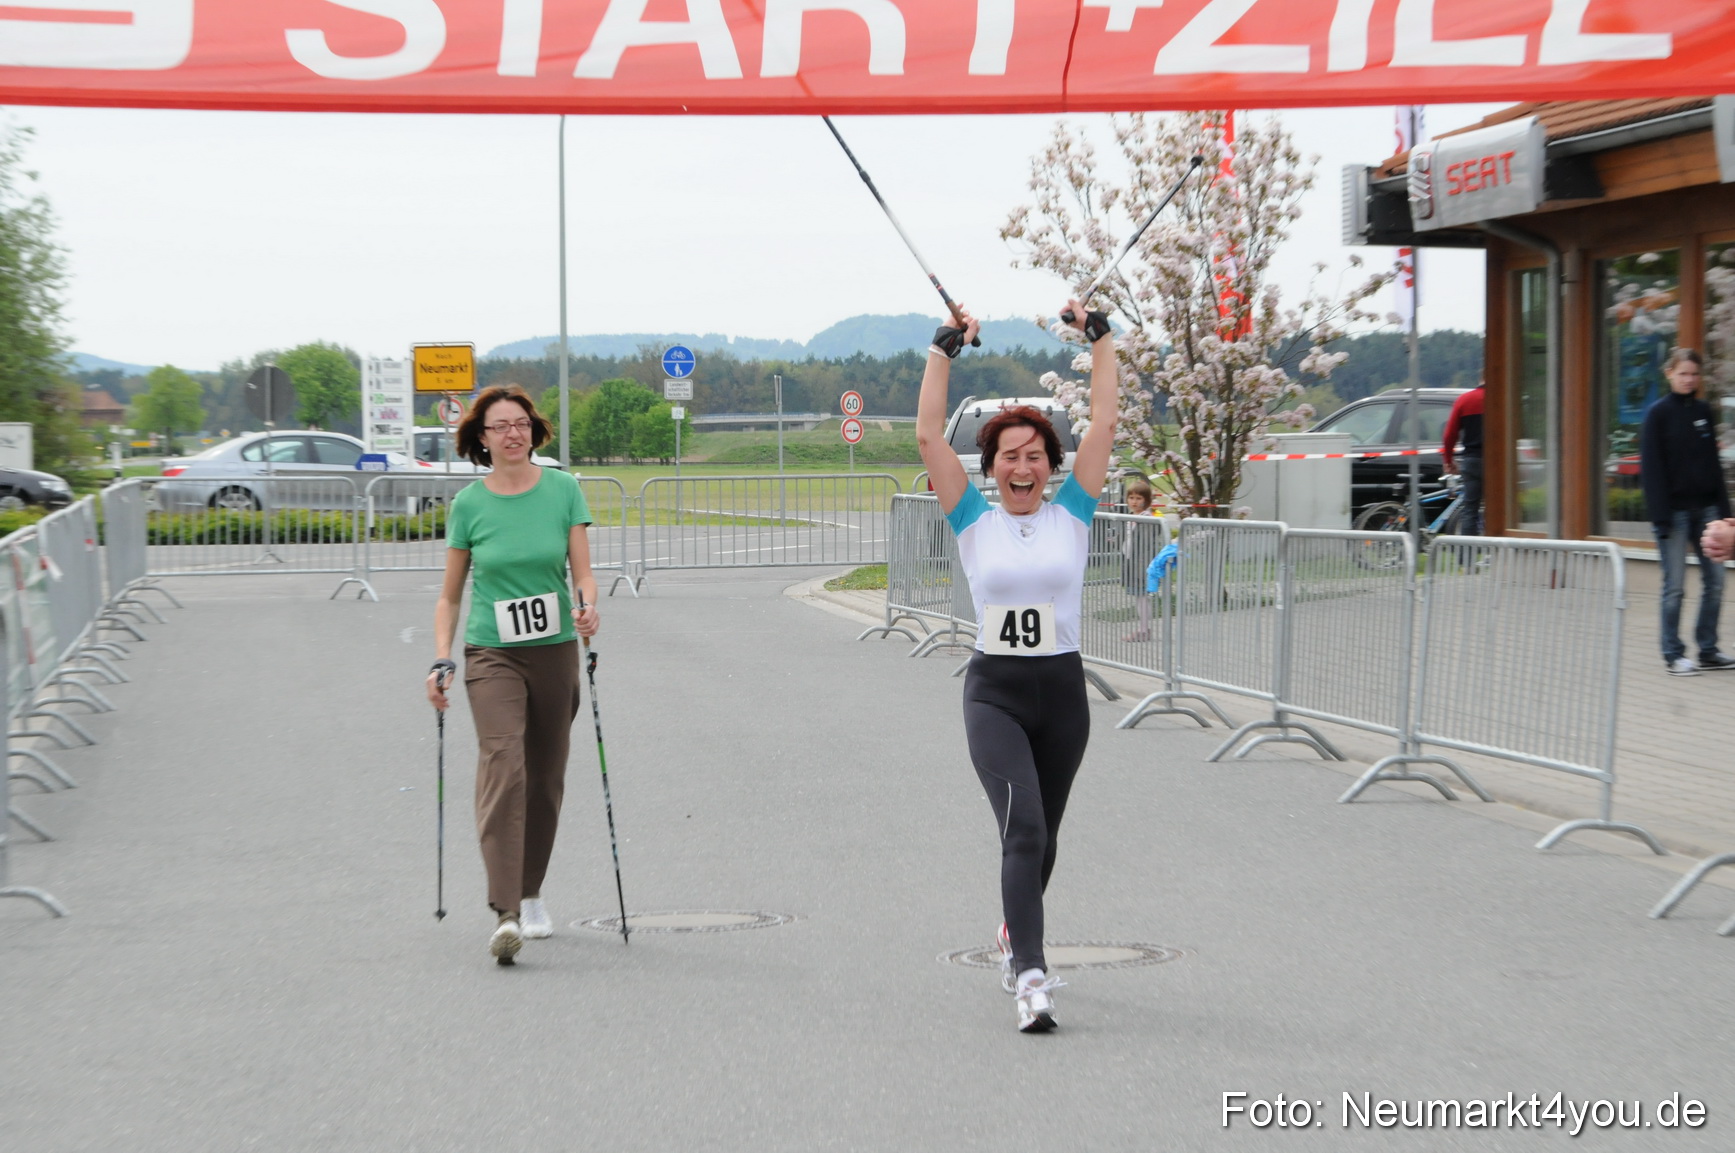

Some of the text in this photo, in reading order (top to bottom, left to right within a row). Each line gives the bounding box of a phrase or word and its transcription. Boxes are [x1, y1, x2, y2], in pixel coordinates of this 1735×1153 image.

[1446, 150, 1516, 196] SEAT
[420, 362, 468, 374] Neumarkt
[846, 398, 858, 410] 60
[507, 597, 548, 636] 119
[999, 608, 1041, 649] 49
